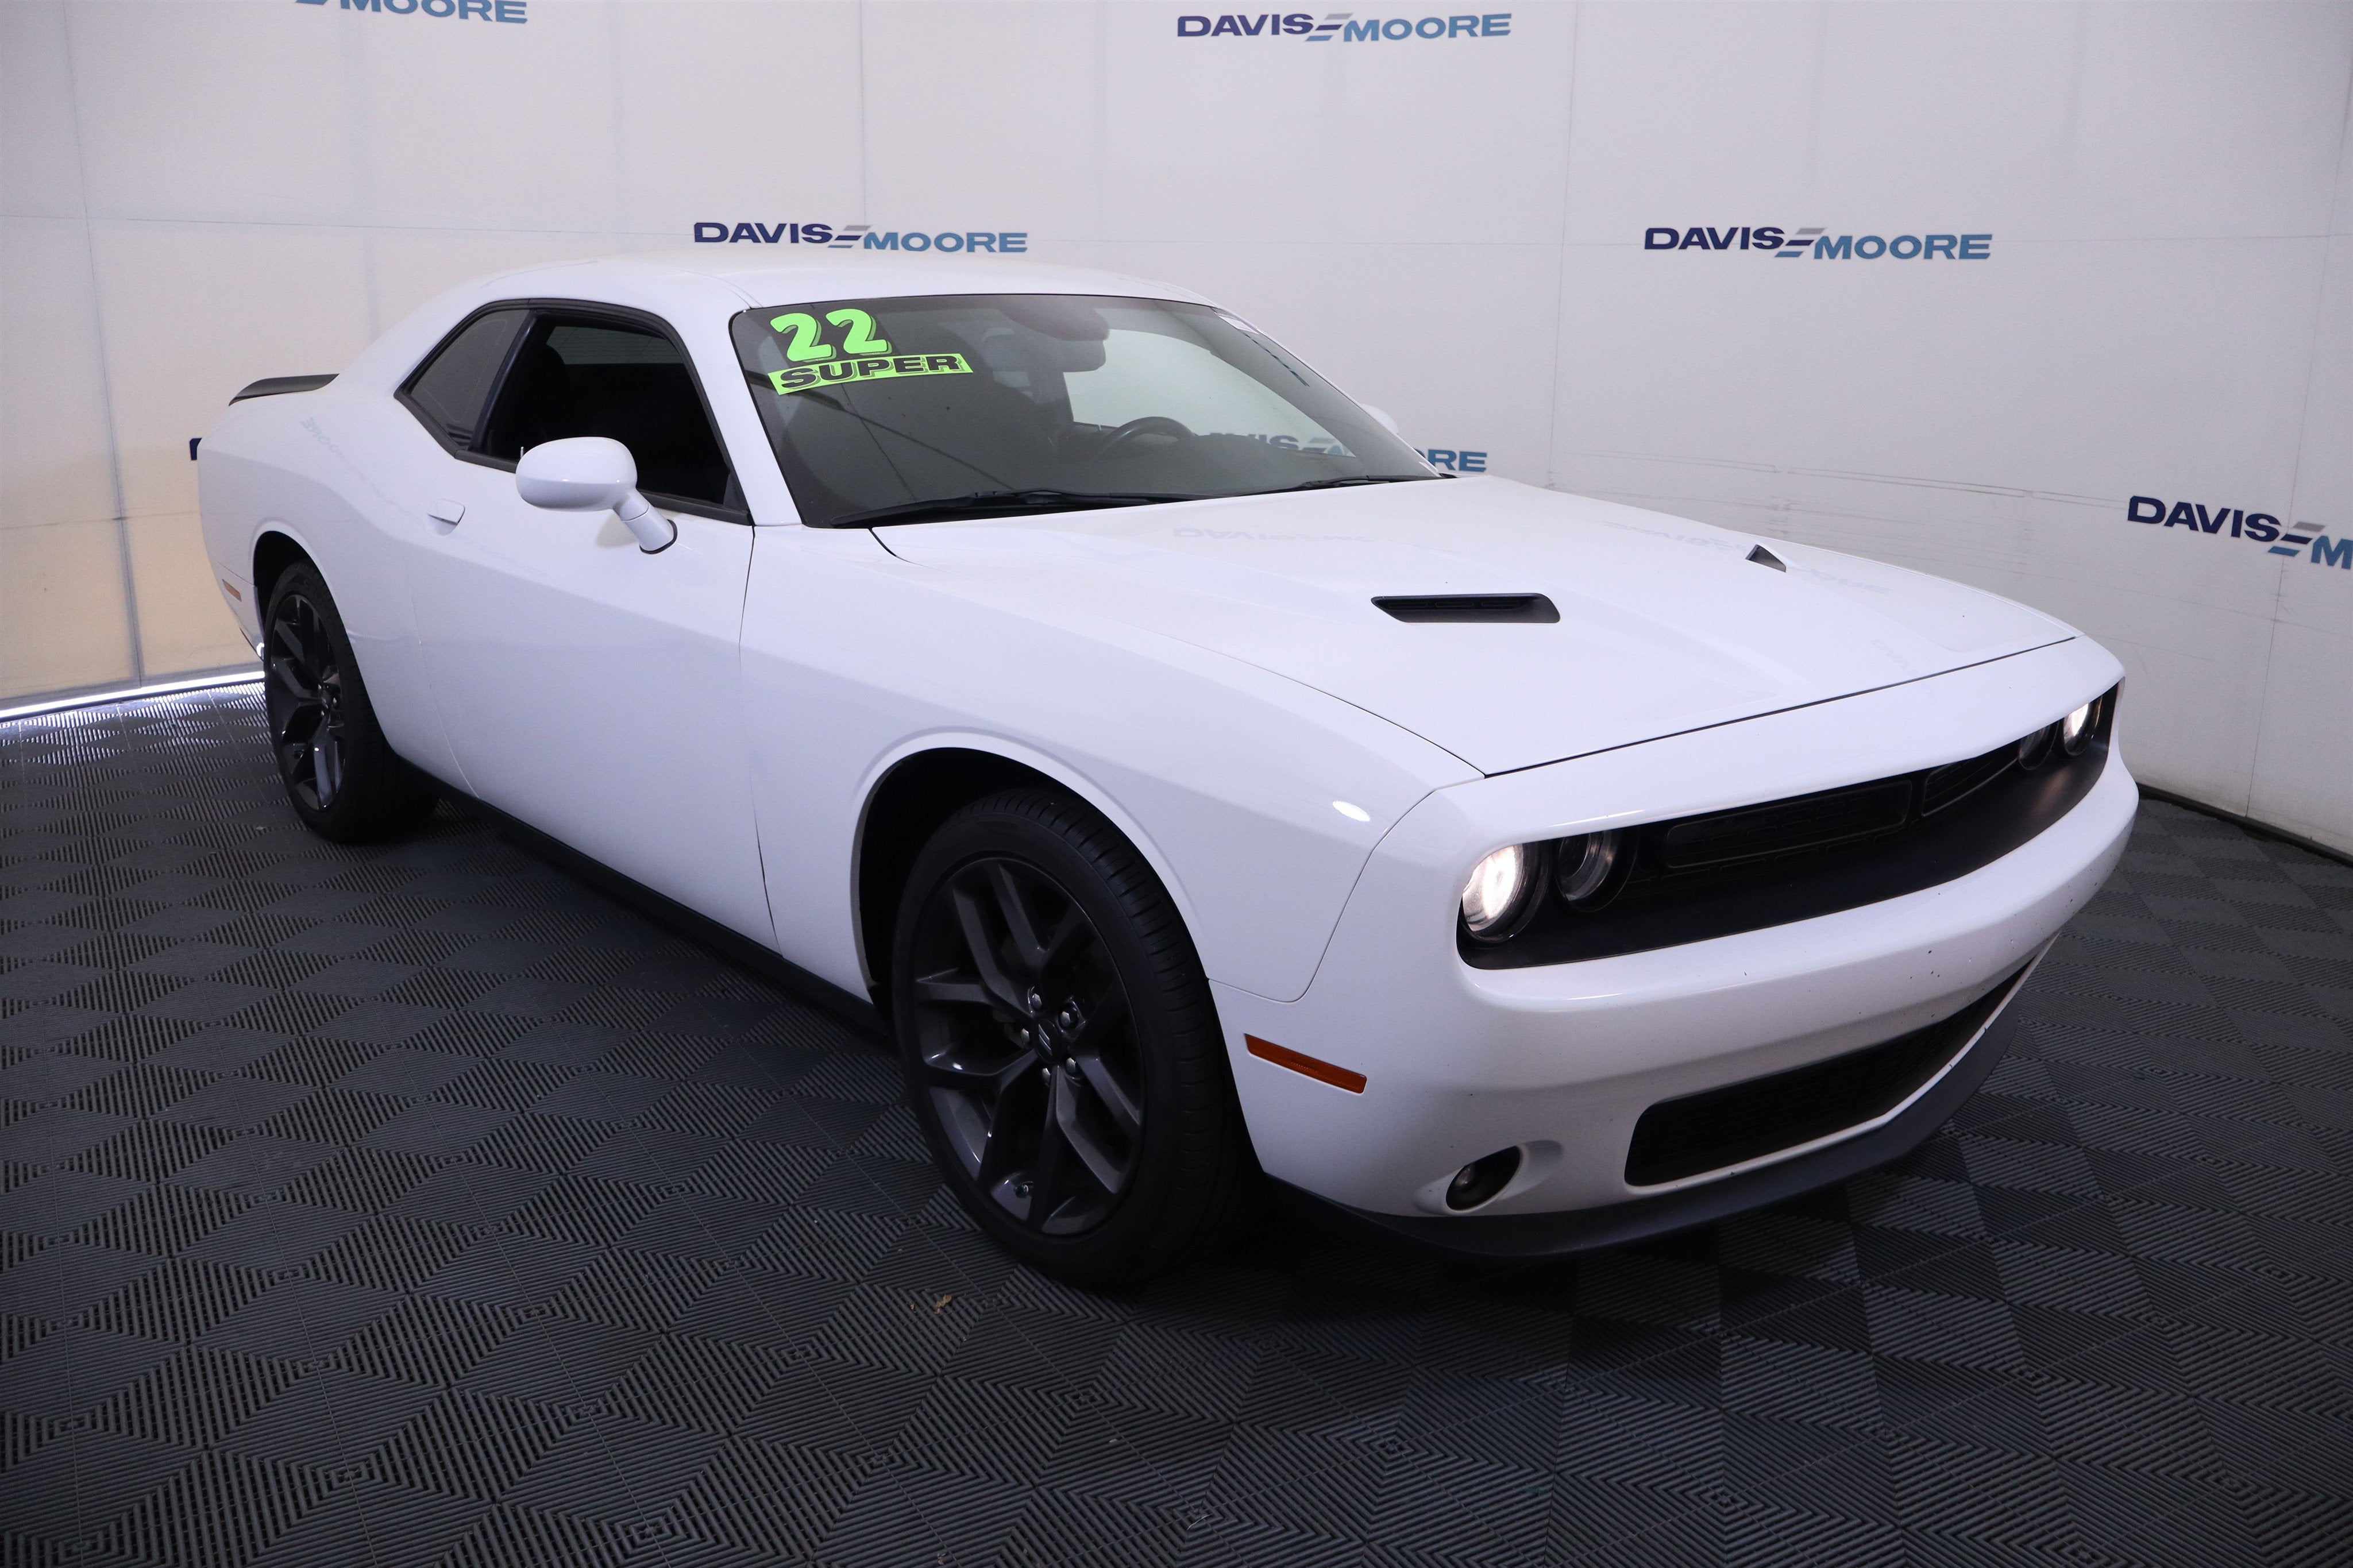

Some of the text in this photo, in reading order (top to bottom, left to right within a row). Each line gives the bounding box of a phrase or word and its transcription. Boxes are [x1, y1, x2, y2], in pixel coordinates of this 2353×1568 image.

[1177, 13, 1511, 42] DAVIS MOORE
[693, 222, 1027, 253] DAVIS MOORE
[1644, 227, 1992, 260] DAVIS MOORE
[770, 308, 892, 362] 22
[780, 356, 963, 389] SUPER
[2127, 495, 2281, 542] DAVIS
